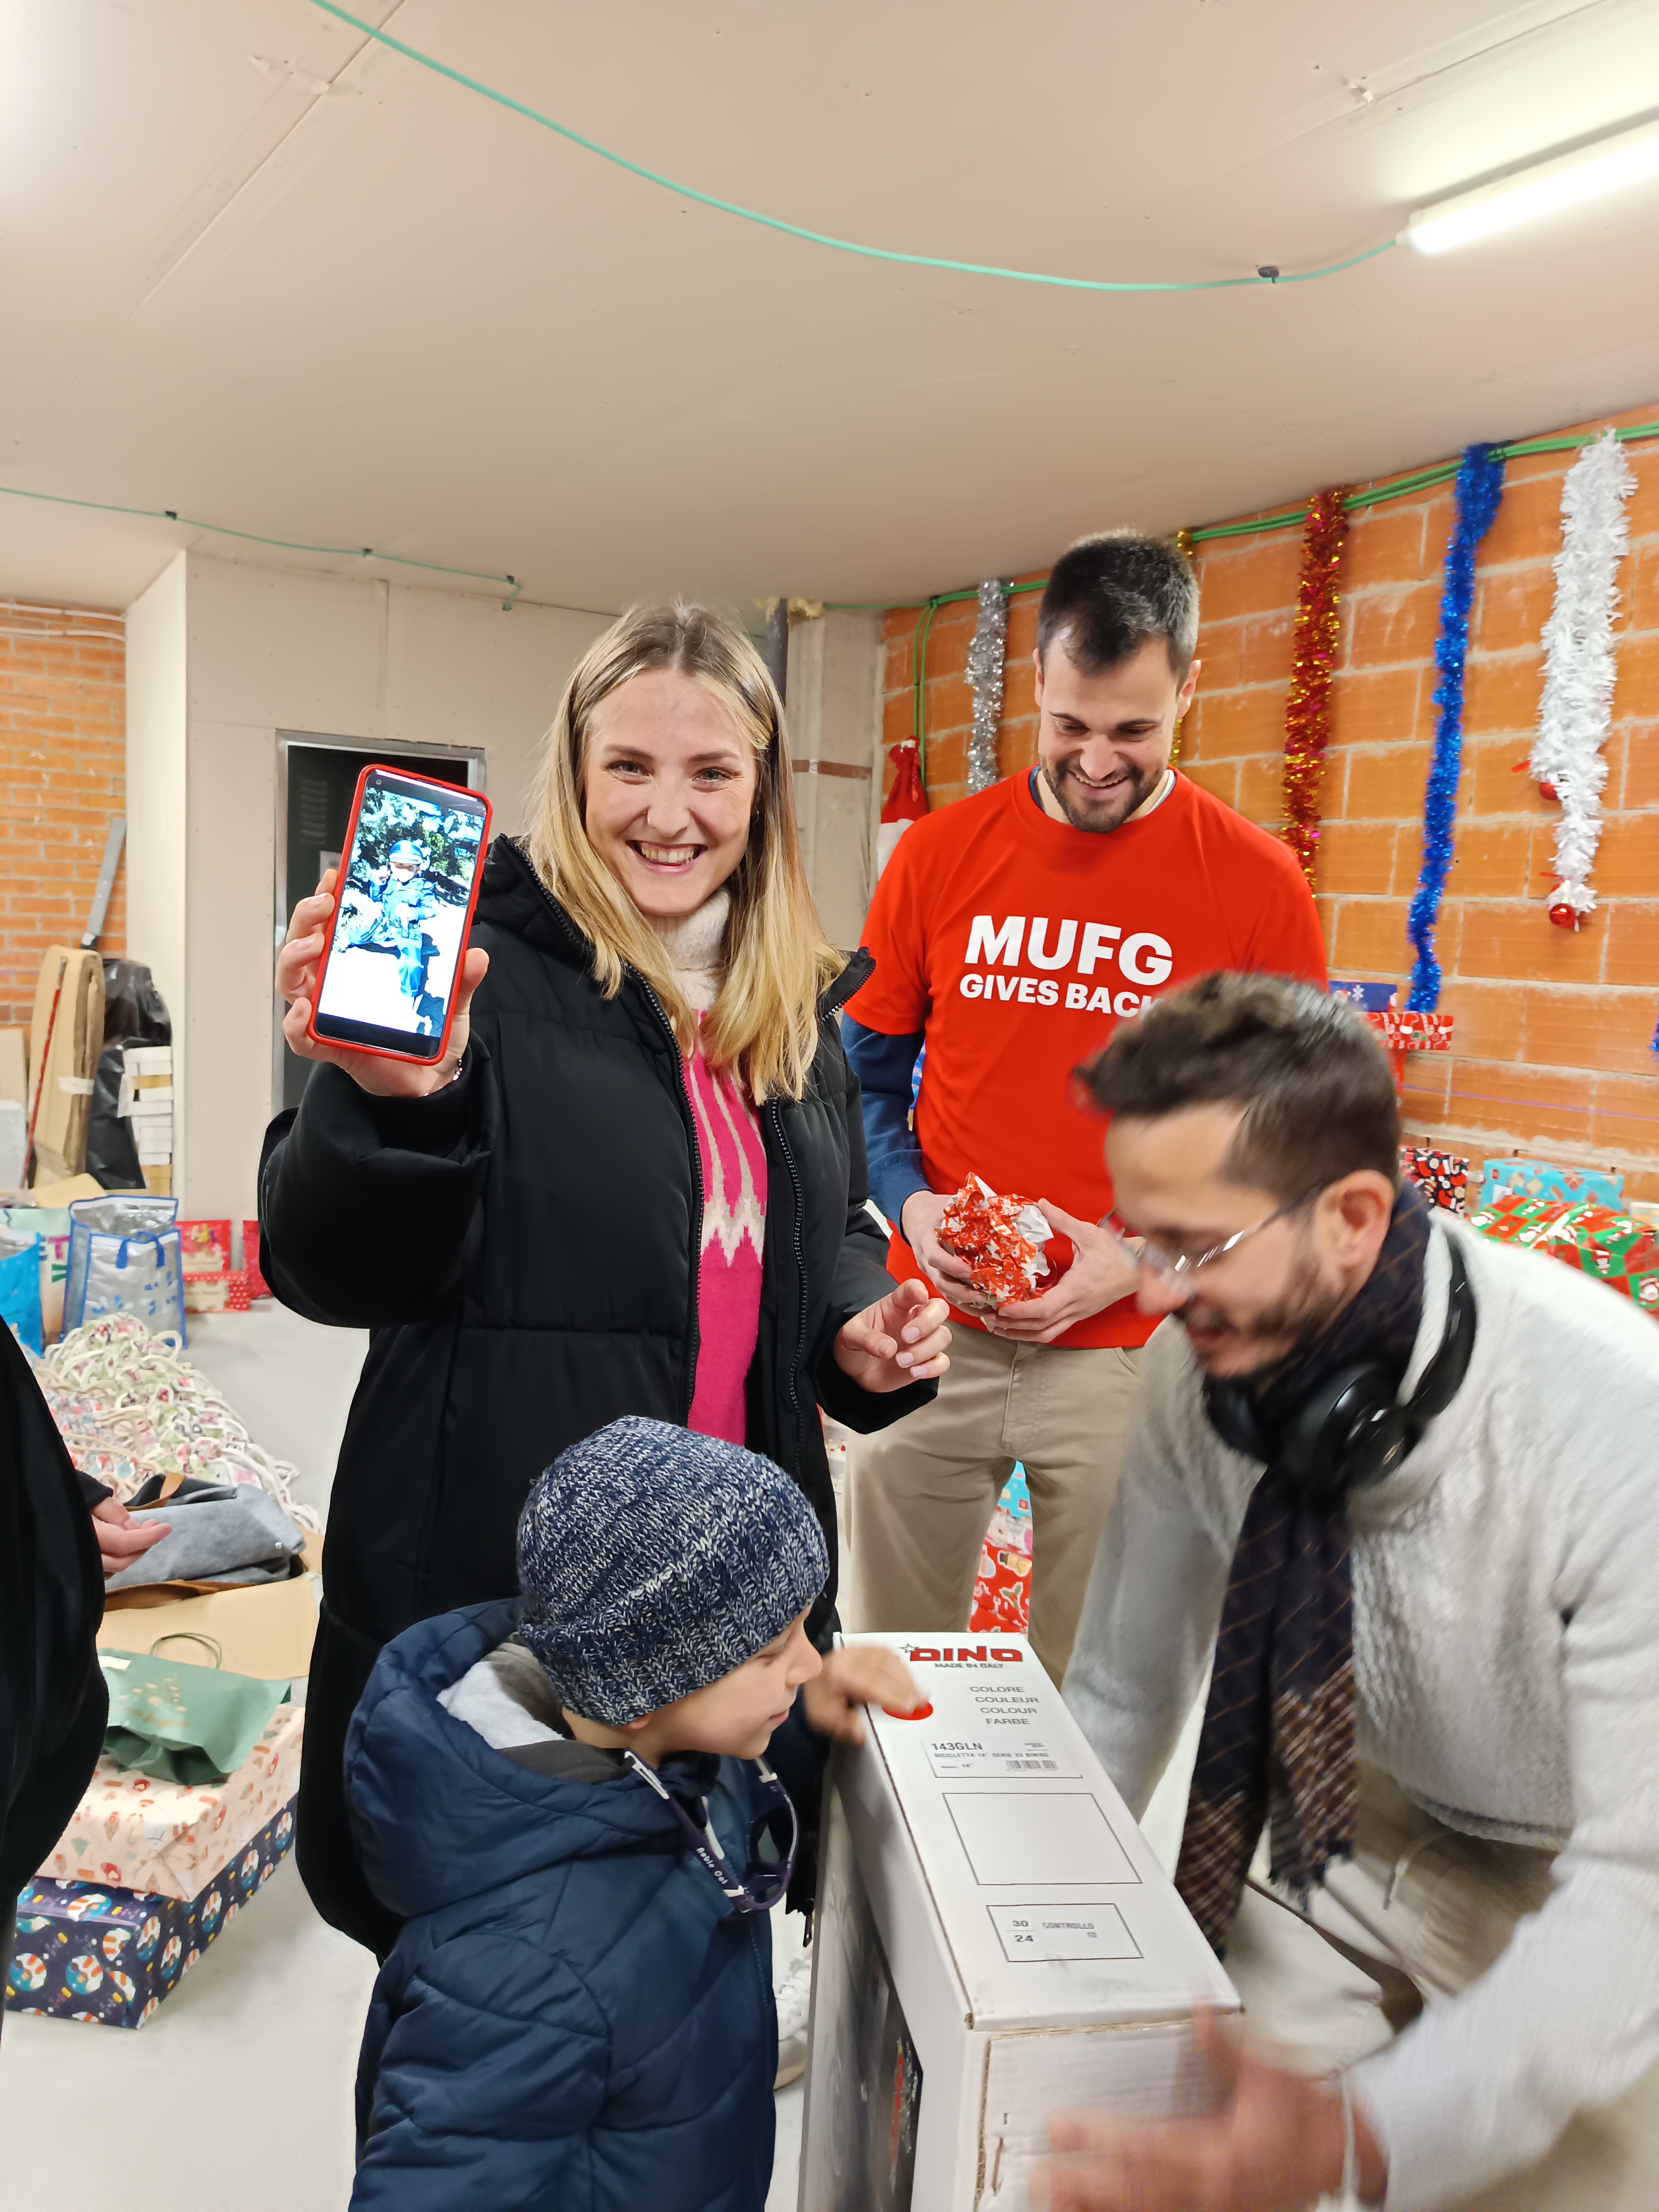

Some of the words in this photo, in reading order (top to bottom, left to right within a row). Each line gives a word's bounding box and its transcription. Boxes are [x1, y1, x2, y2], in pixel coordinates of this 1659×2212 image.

[964, 915, 1173, 985] MUFG
[959, 973, 1059, 1005] GIVES
[910, 1646, 1023, 1662] DINO
